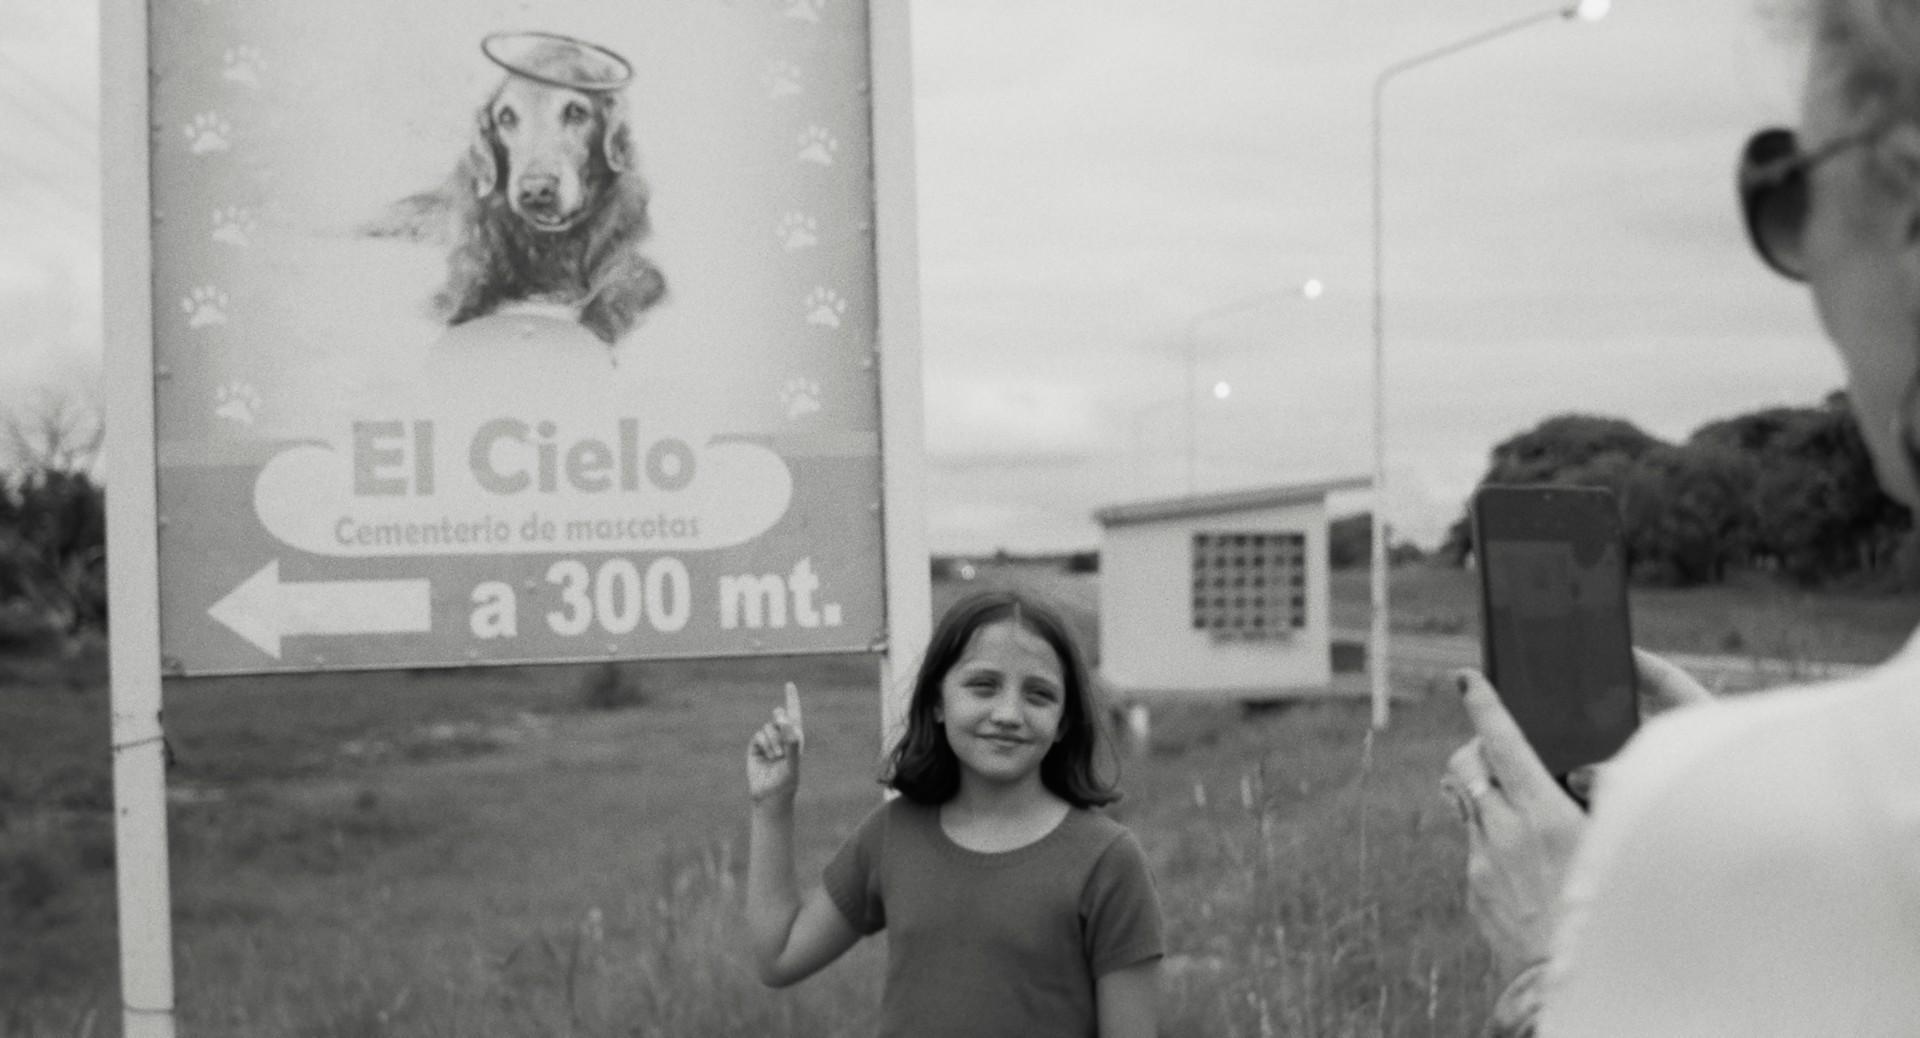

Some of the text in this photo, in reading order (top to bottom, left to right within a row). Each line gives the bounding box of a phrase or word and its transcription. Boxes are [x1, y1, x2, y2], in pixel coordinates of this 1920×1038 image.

[353, 417, 697, 497] El Cielo
[334, 513, 700, 546] Cementerio de mascotas
[469, 557, 843, 639] a 300 mt.
